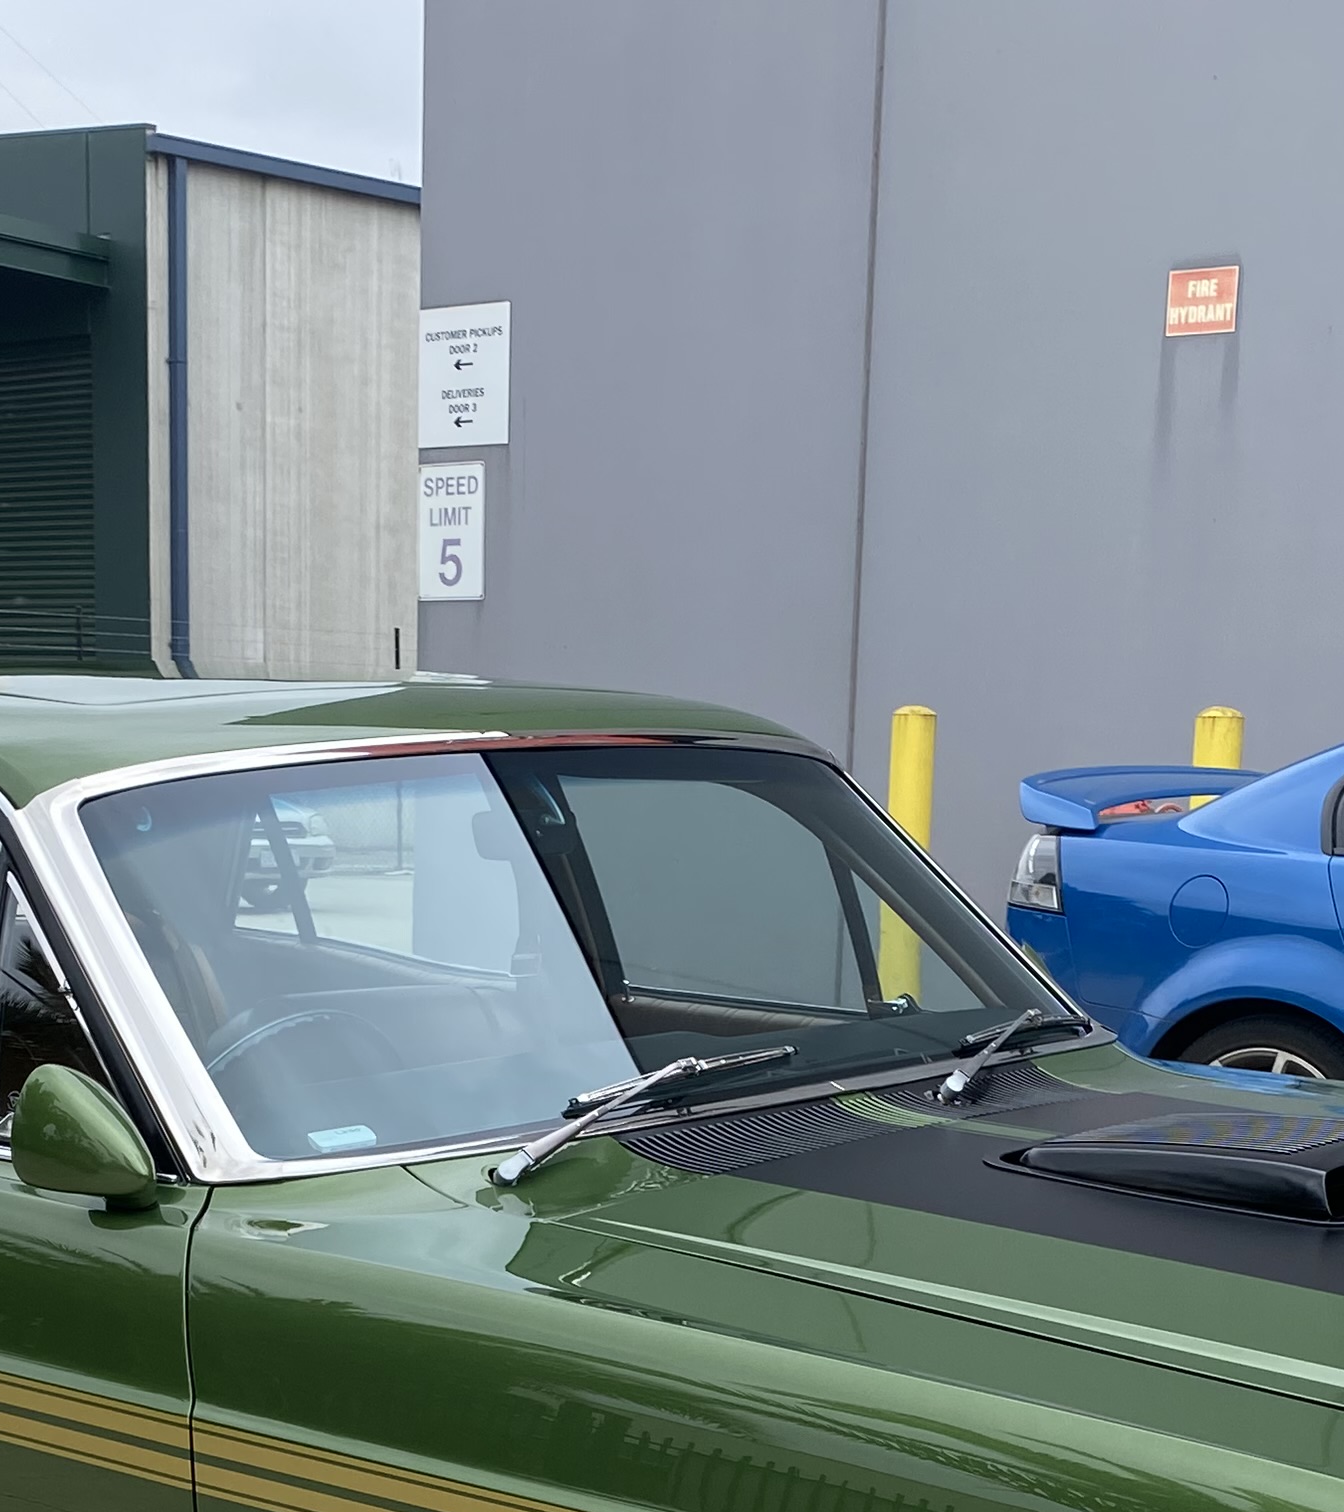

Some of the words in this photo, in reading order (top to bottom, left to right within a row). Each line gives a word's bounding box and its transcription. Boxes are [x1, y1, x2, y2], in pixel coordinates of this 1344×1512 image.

[1187, 278, 1219, 299] FIRE
[1168, 303, 1233, 325] HYDRANT
[425, 329, 468, 342] CUSTOMER
[469, 325, 504, 338] PICKUPS
[449, 343, 471, 355] DOOR
[472, 343, 479, 353] 2
[441, 387, 485, 400] DELIVERIES
[448, 403, 470, 414] DOOR
[471, 402, 478, 413] 3
[423, 475, 479, 497] SPEED
[429, 506, 472, 527] LIMIT
[438, 538, 463, 587] 5
